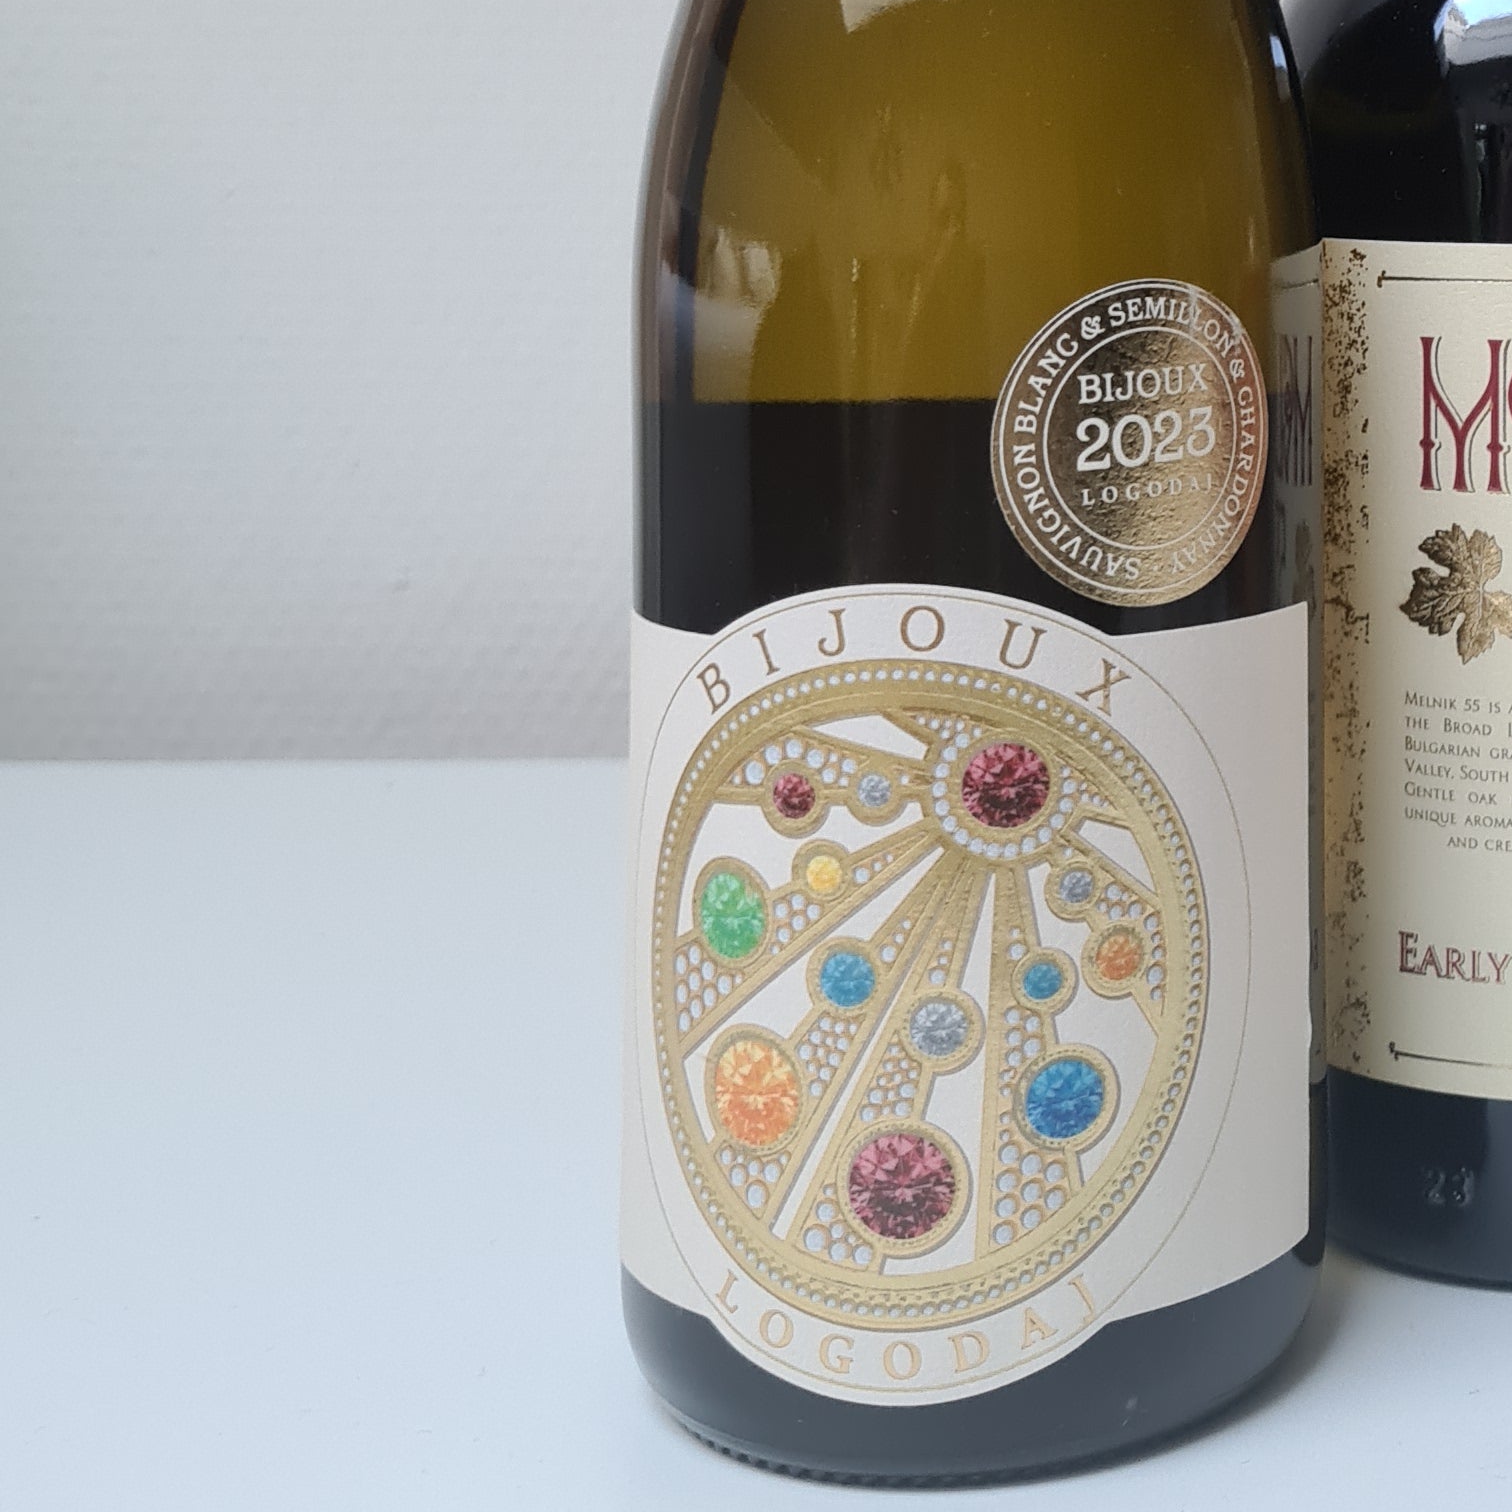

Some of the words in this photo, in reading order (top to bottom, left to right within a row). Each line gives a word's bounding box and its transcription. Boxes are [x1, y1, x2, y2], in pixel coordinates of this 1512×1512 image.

[1080, 315, 1106, 340] &
[1107, 295, 1241, 359] SEMILLON
[1229, 358, 1246, 380] &
[1014, 335, 1079, 435] BLANC
[1076, 363, 1210, 405] BIJOUX
[1076, 406, 1216, 472] 2023
[1081, 476, 1215, 506] LOGODAJ
[1171, 386, 1258, 575] CHARDONNAY
[1013, 442, 1142, 580] SAUVIGNON
[696, 605, 1131, 716] BIJOUX
[1404, 691, 1457, 710] MELNIK
[1464, 699, 1480, 712] 55
[1489, 702, 1500, 714] IS
[1404, 716, 1429, 730] THE
[1443, 717, 1492, 736] BROAD
[1404, 735, 1481, 758] BULGARIAN
[1460, 765, 1509, 783] SOUTH
[1404, 781, 1455, 802] GENTLE
[1468, 792, 1498, 806] OAK
[1404, 807, 1457, 827] UNIQUE
[1447, 837, 1478, 849] AND
[715, 1269, 1097, 1381] LOGODAJ
